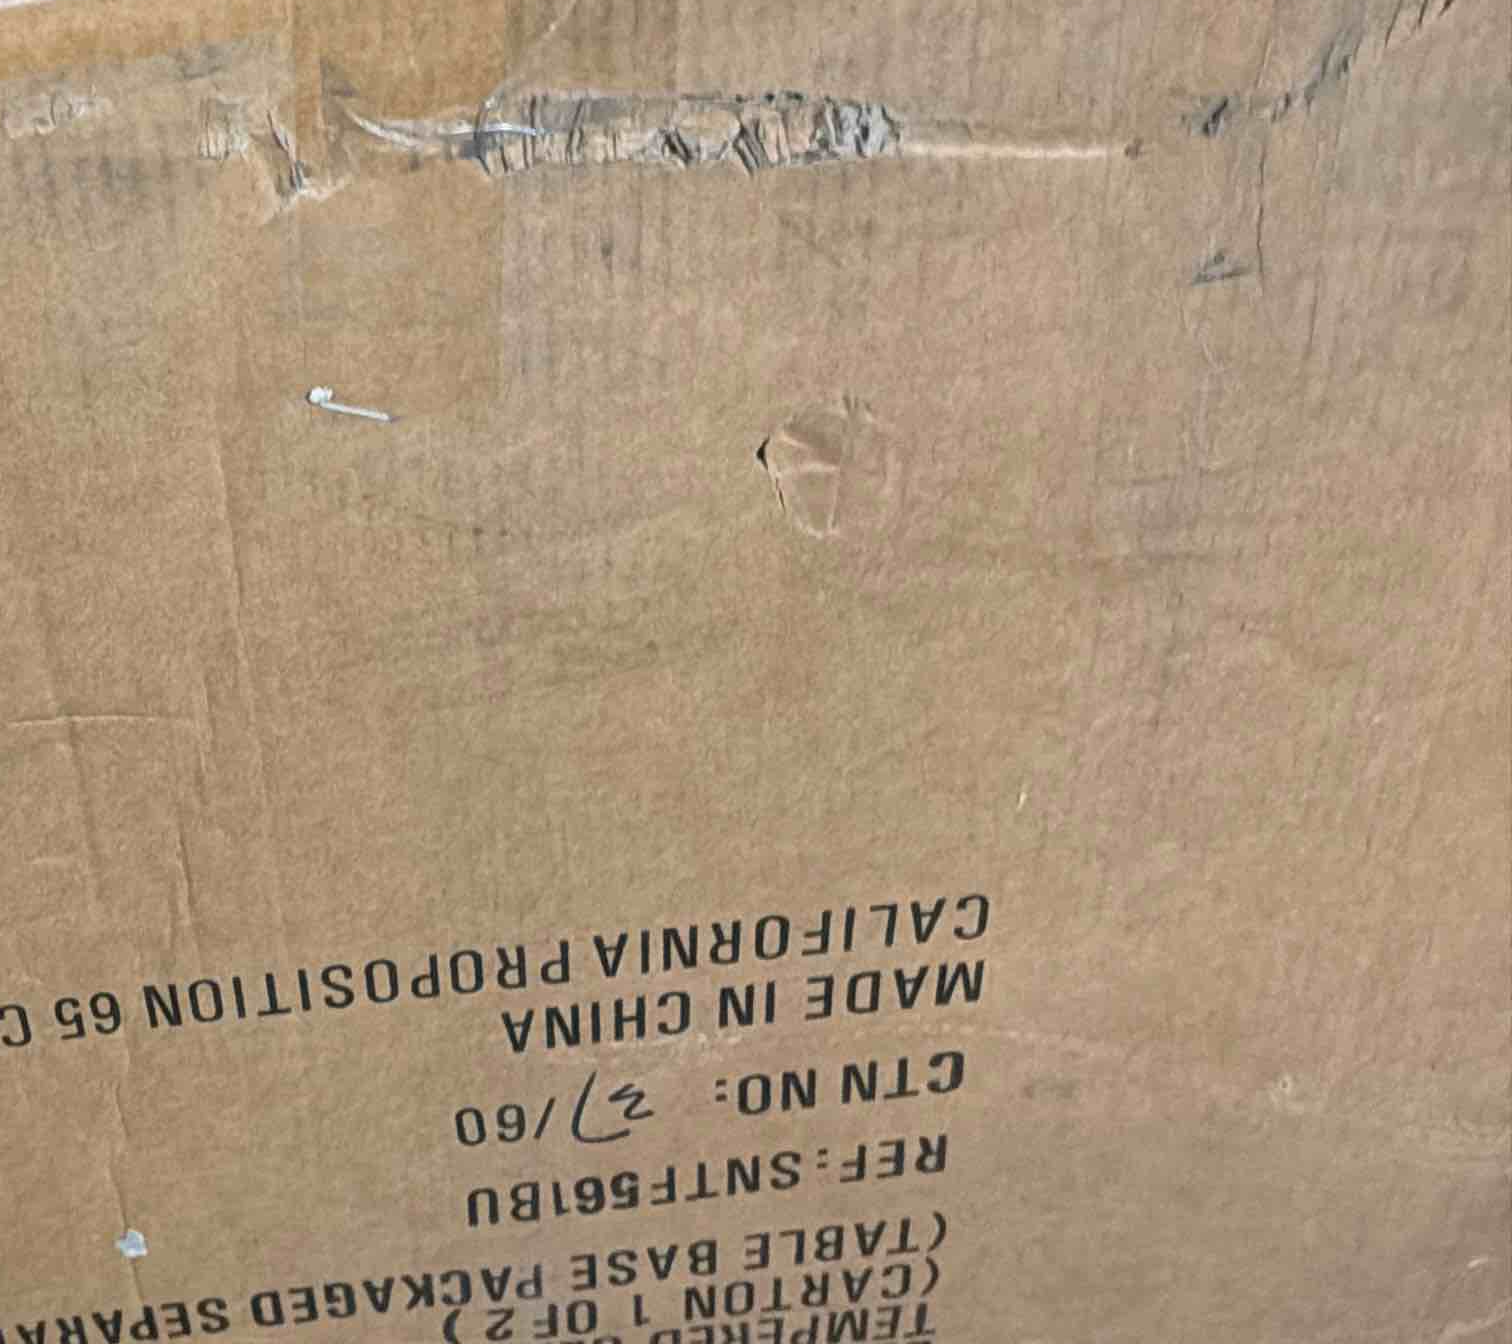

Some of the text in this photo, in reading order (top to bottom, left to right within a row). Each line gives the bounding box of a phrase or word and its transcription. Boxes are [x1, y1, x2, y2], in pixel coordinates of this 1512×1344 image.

[593, 893, 992, 979] CALIFORNIA
[143, 939, 571, 1028] PROPOSITION
[500, 959, 987, 1054] MADE IN CHINA
[53, 991, 123, 1041] 65
[714, 1068, 818, 1117] NO:
[840, 1051, 966, 1106] CTN
[466, 1134, 949, 1227] REF:SNTF561BU
[572, 1239, 718, 1290] BASE
[744, 1211, 948, 1271] (TABLE
[251, 1264, 544, 1327] PACKAGED
[534, 1300, 598, 1338] OF
[632, 1295, 650, 1327] 1
[684, 1258, 941, 1321] (CARTON
